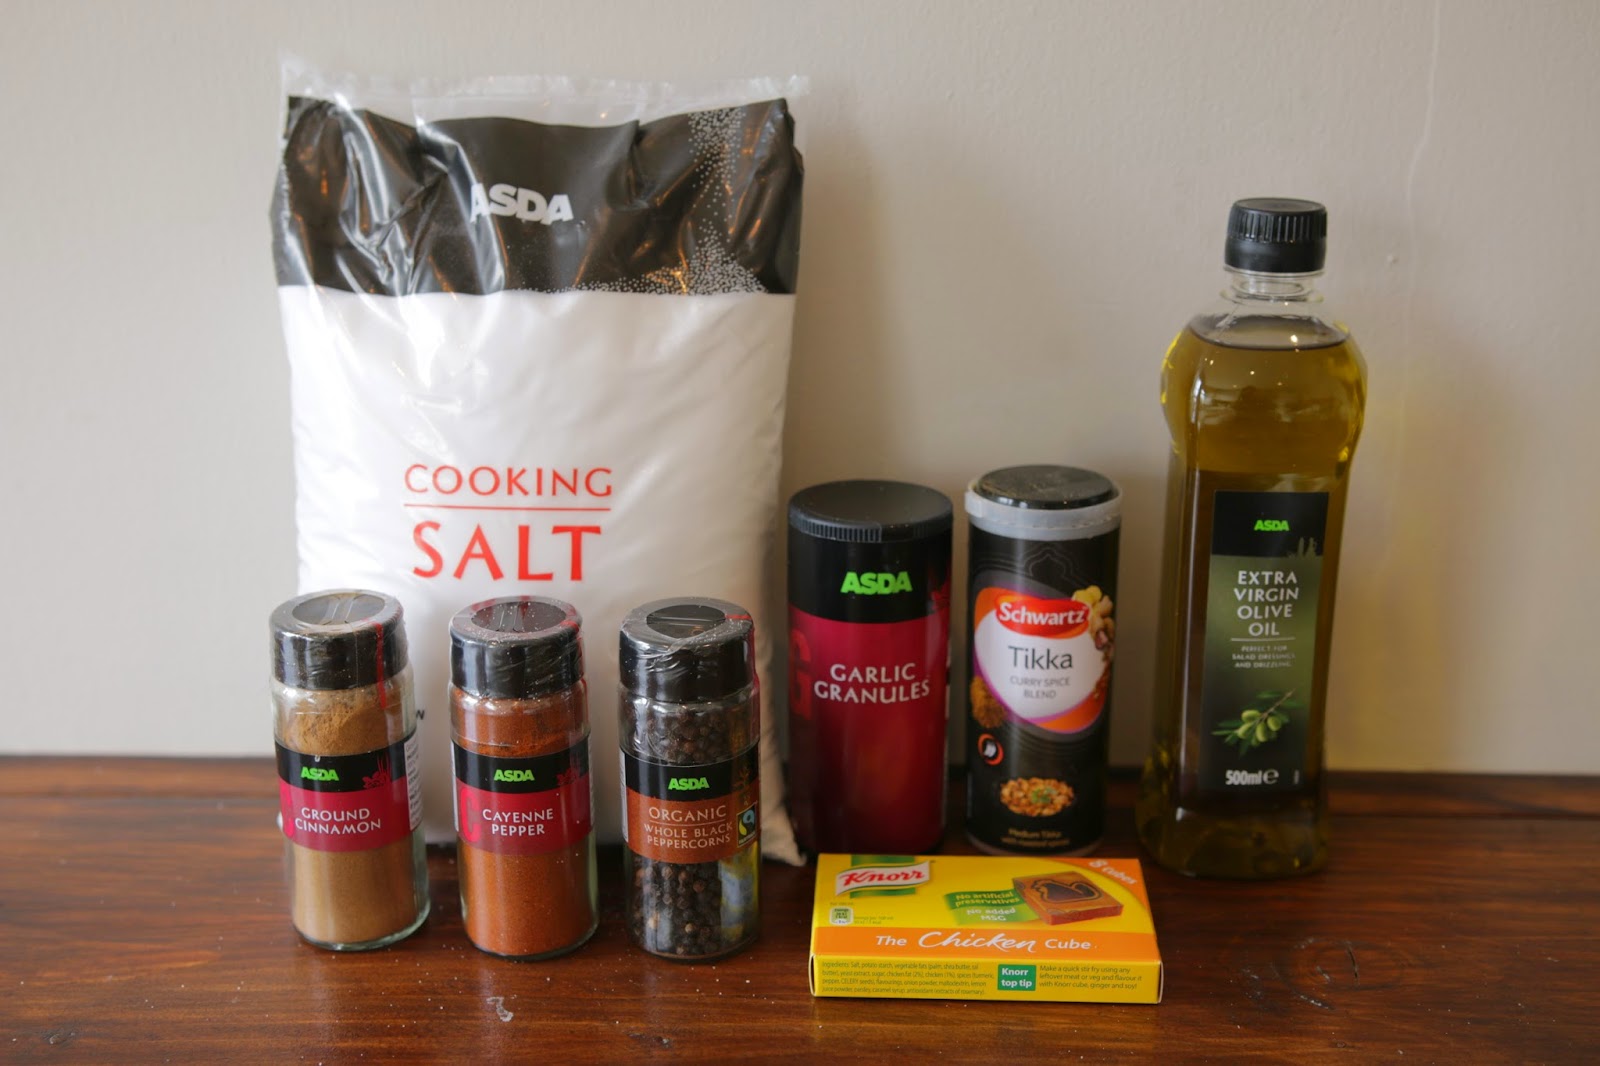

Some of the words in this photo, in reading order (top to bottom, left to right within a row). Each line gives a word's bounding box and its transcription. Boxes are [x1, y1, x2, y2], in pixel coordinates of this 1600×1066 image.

[470, 182, 574, 226] ASDA
[404, 464, 612, 497] COOKING
[1254, 520, 1290, 531] ASDA
[412, 521, 602, 581] SALT
[840, 571, 913, 595] ASDA
[1238, 570, 1297, 585] EXTRA
[1234, 587, 1299, 602] VIRGIN
[999, 602, 1085, 625] Schwartz
[1237, 604, 1293, 620] OLIVE
[1248, 622, 1280, 637] OIL
[1008, 645, 1073, 670] Tikka
[1232, 653, 1256, 661] SALAD
[830, 663, 916, 683] GARLIC
[1010, 676, 1041, 686] CURRY
[1044, 676, 1071, 686] SPICE
[814, 680, 930, 704] GRANULES
[1023, 689, 1056, 699] BLEND
[301, 766, 339, 781] ASDA
[494, 769, 535, 782] ASDA
[1225, 769, 1263, 785] 500ml
[668, 777, 710, 791] ASDA
[301, 807, 370, 822] GROUND
[482, 808, 554, 823] CAYENNE
[649, 805, 727, 822] ORGANIC
[295, 818, 381, 835] CINNAMON
[491, 823, 545, 836] PEPPER
[644, 823, 688, 839] WHOLE
[694, 821, 733, 838] BLACK
[647, 833, 731, 849] PEPPERCORNS
[839, 870, 925, 886] Knorr
[955, 897, 1020, 907] preservatives
[973, 891, 1014, 899] artificial
[985, 907, 1016, 915] added
[875, 936, 907, 946] The
[918, 931, 1037, 953] Chicken
[1045, 938, 1091, 949] Cube
[1001, 967, 1029, 976] Knorr
[1001, 979, 1018, 988] top
[1019, 979, 1032, 988] tip
